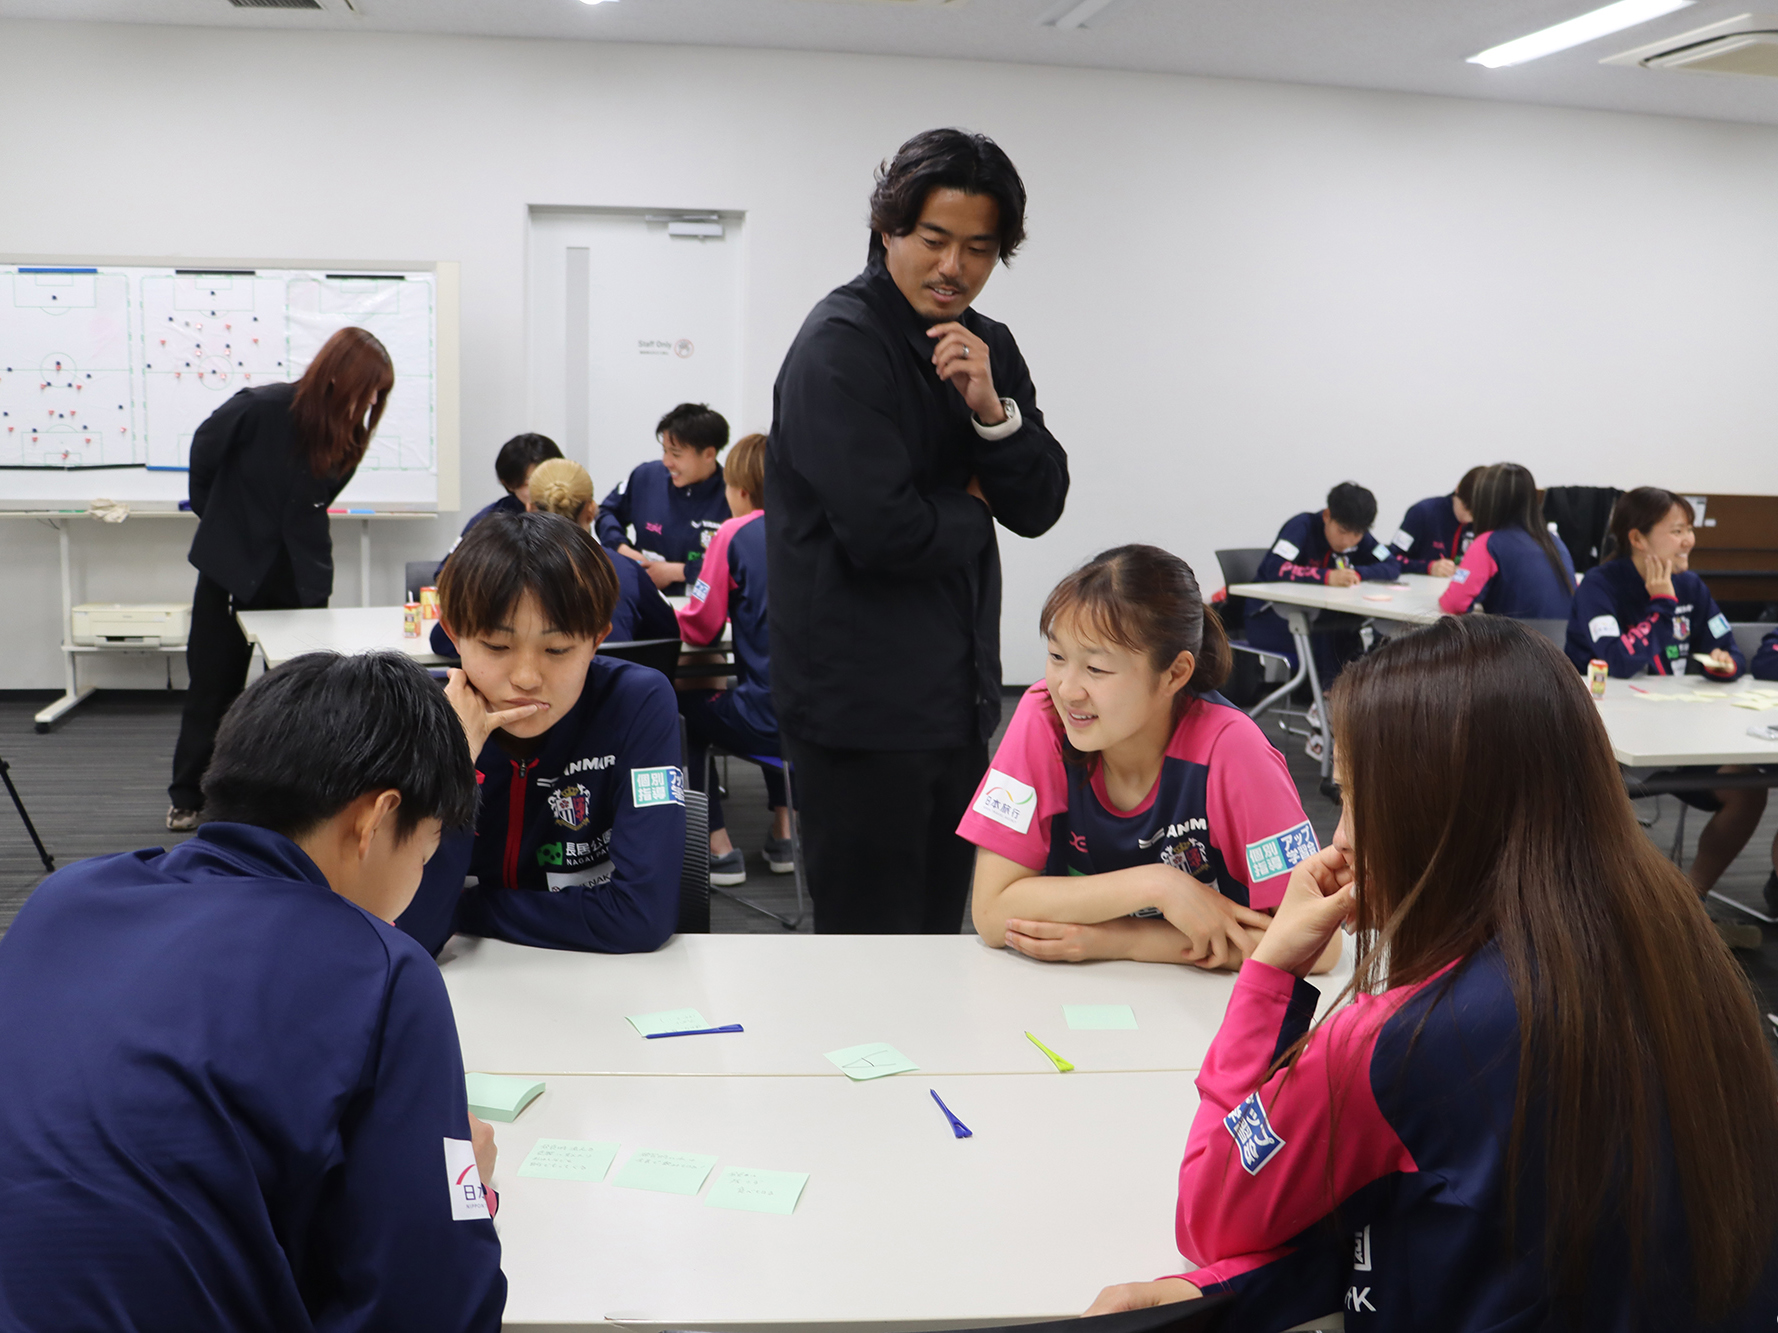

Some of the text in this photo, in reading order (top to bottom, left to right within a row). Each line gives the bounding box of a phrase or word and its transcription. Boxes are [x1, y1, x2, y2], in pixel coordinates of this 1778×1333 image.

[638, 340, 672, 350] Staff Only
[985, 795, 1021, 819] 日本旅行
